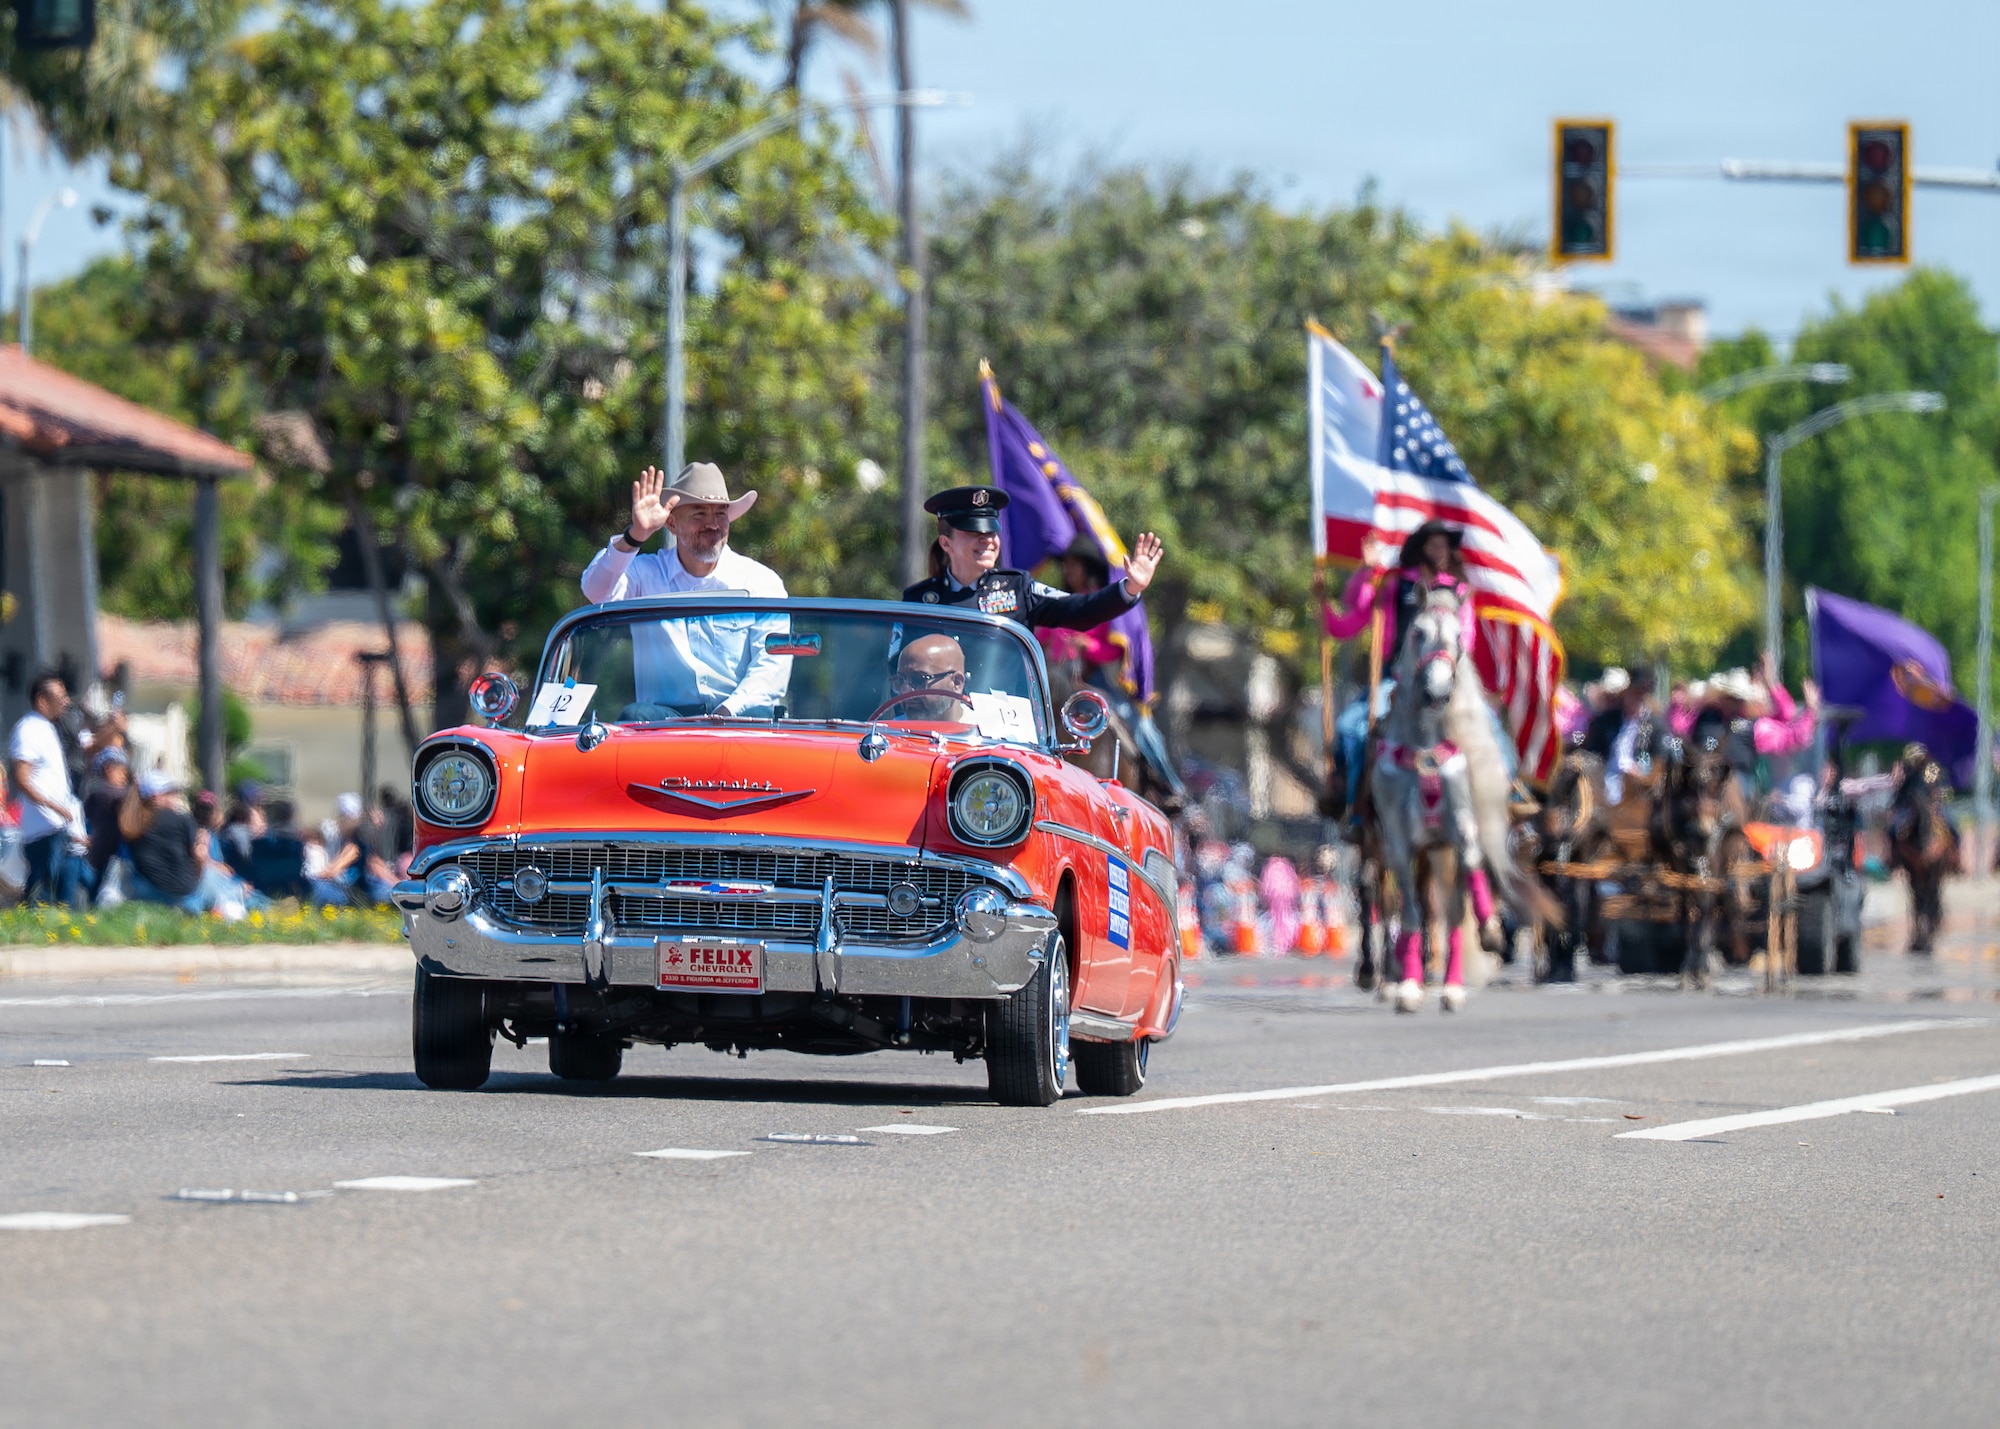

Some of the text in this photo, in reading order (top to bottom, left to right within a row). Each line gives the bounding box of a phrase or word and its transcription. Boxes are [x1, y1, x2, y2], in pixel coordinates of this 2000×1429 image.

[549, 694, 573, 712] 42
[690, 948, 752, 966] FELIX
[690, 964, 753, 974] CHEVROLET
